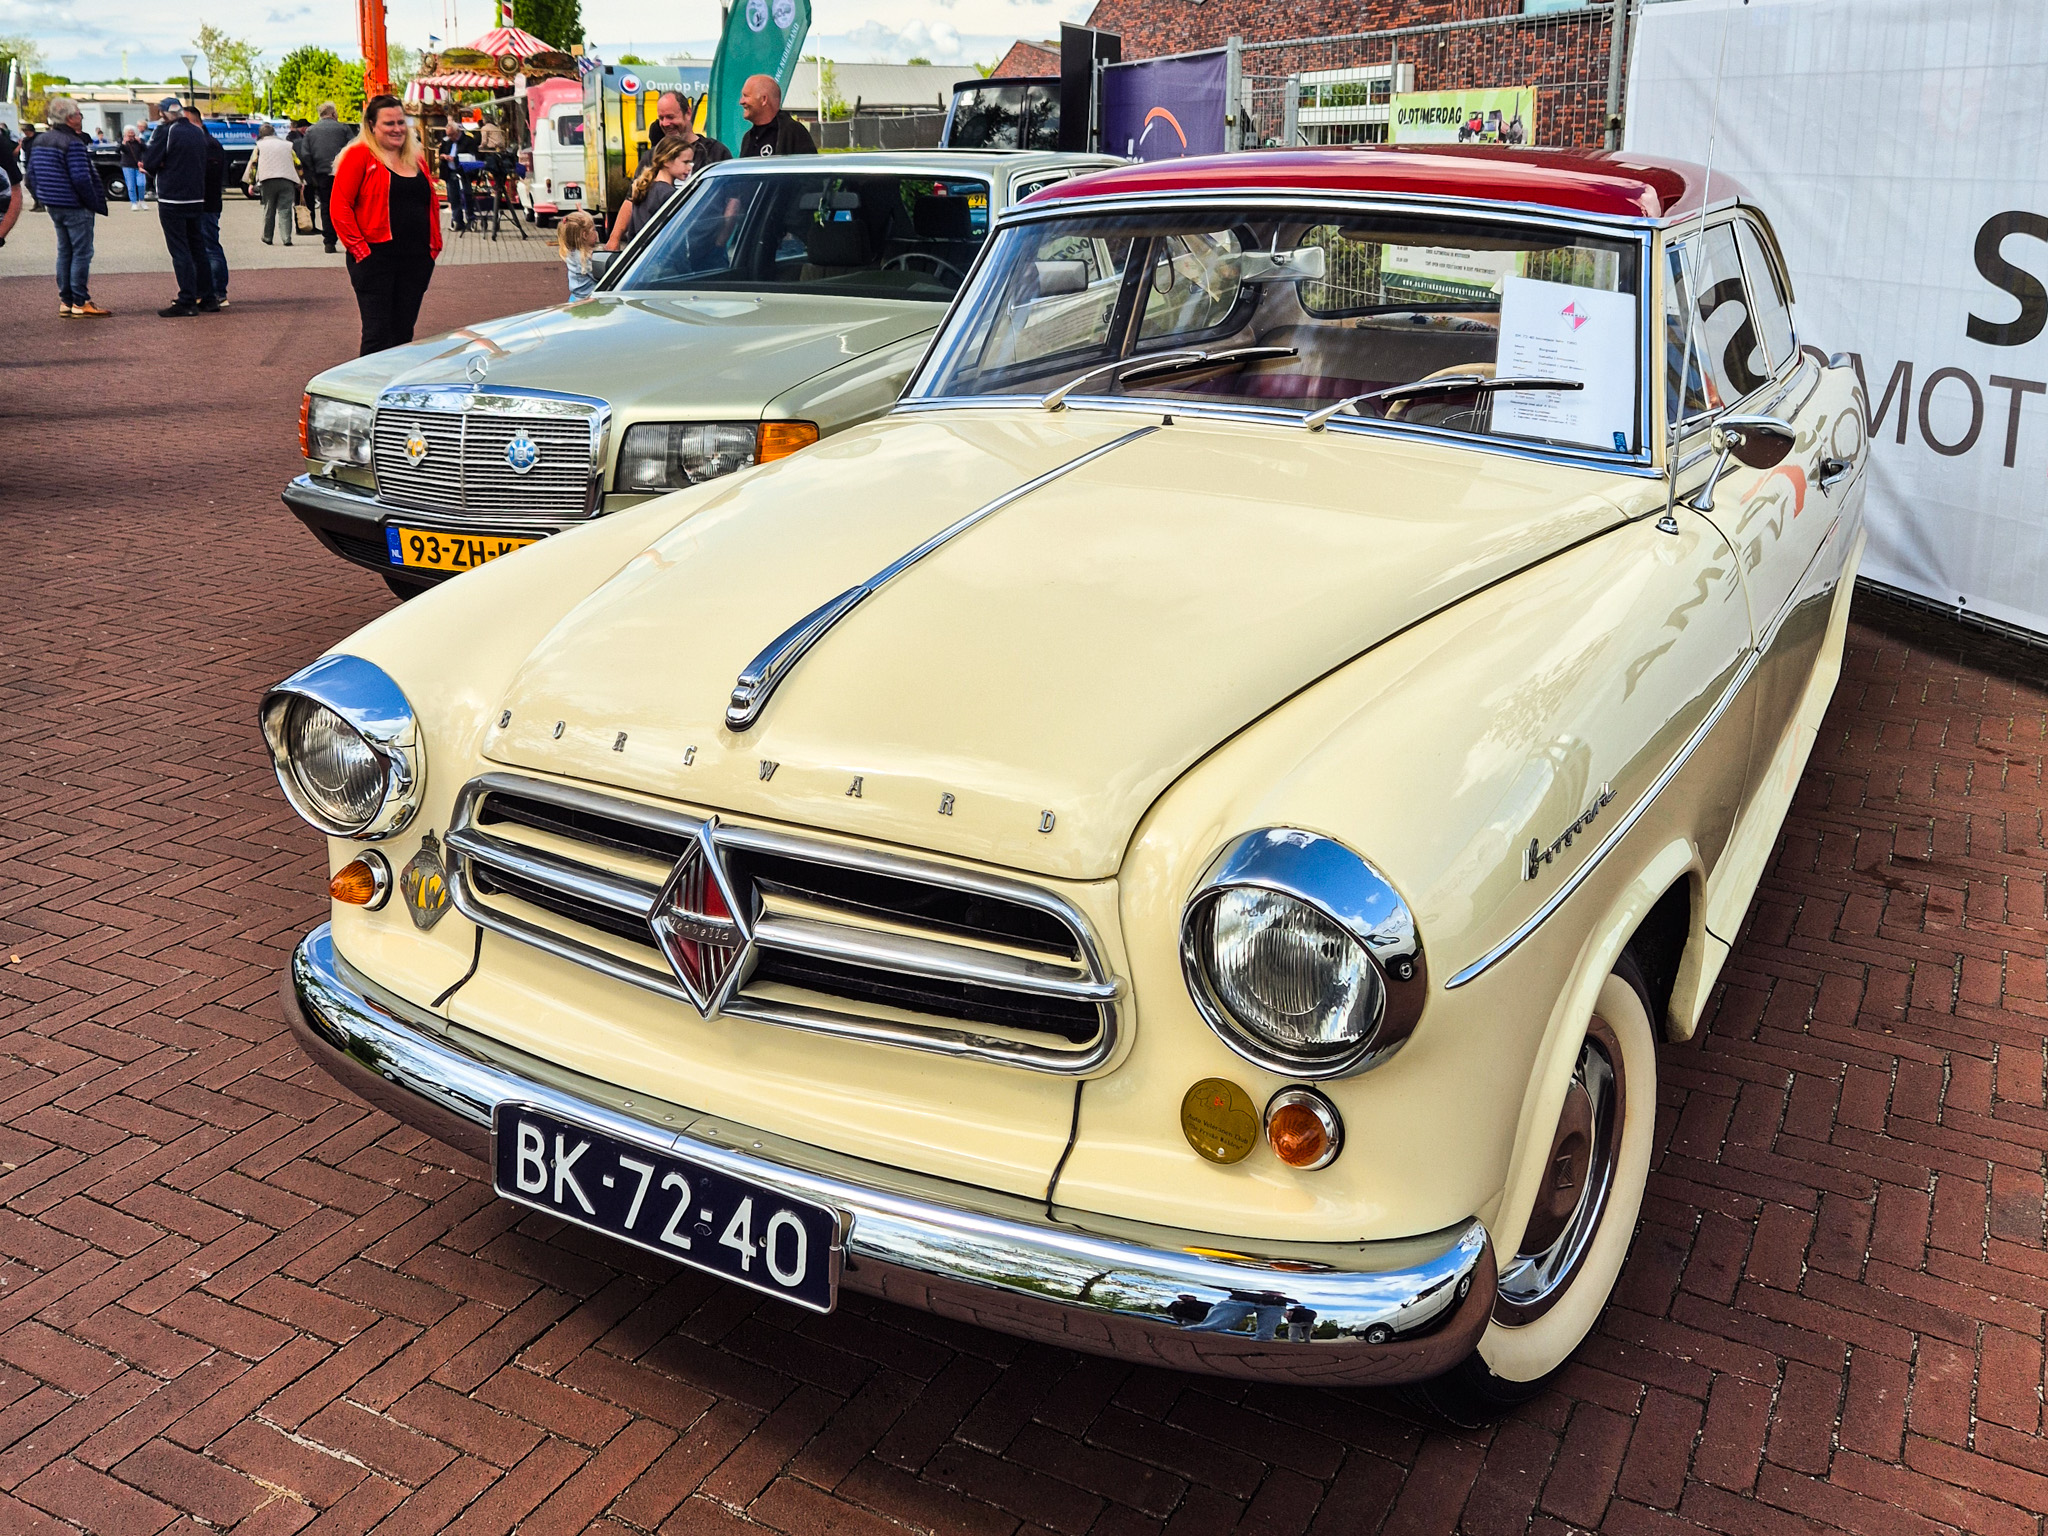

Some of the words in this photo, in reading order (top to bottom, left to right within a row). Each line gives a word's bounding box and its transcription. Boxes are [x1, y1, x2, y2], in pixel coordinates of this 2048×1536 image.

[780, 22, 800, 70] NEDERLAND
[646, 80, 692, 92] Omrop
[1397, 106, 1463, 125] OLDTIMERDAG
[392, 549, 402, 559] NL
[1187, 1113, 1202, 1124] Auto
[1203, 1119, 1233, 1137] Veteranen
[1234, 1132, 1249, 1144] Club
[516, 1119, 808, 1287] BK-72-40
